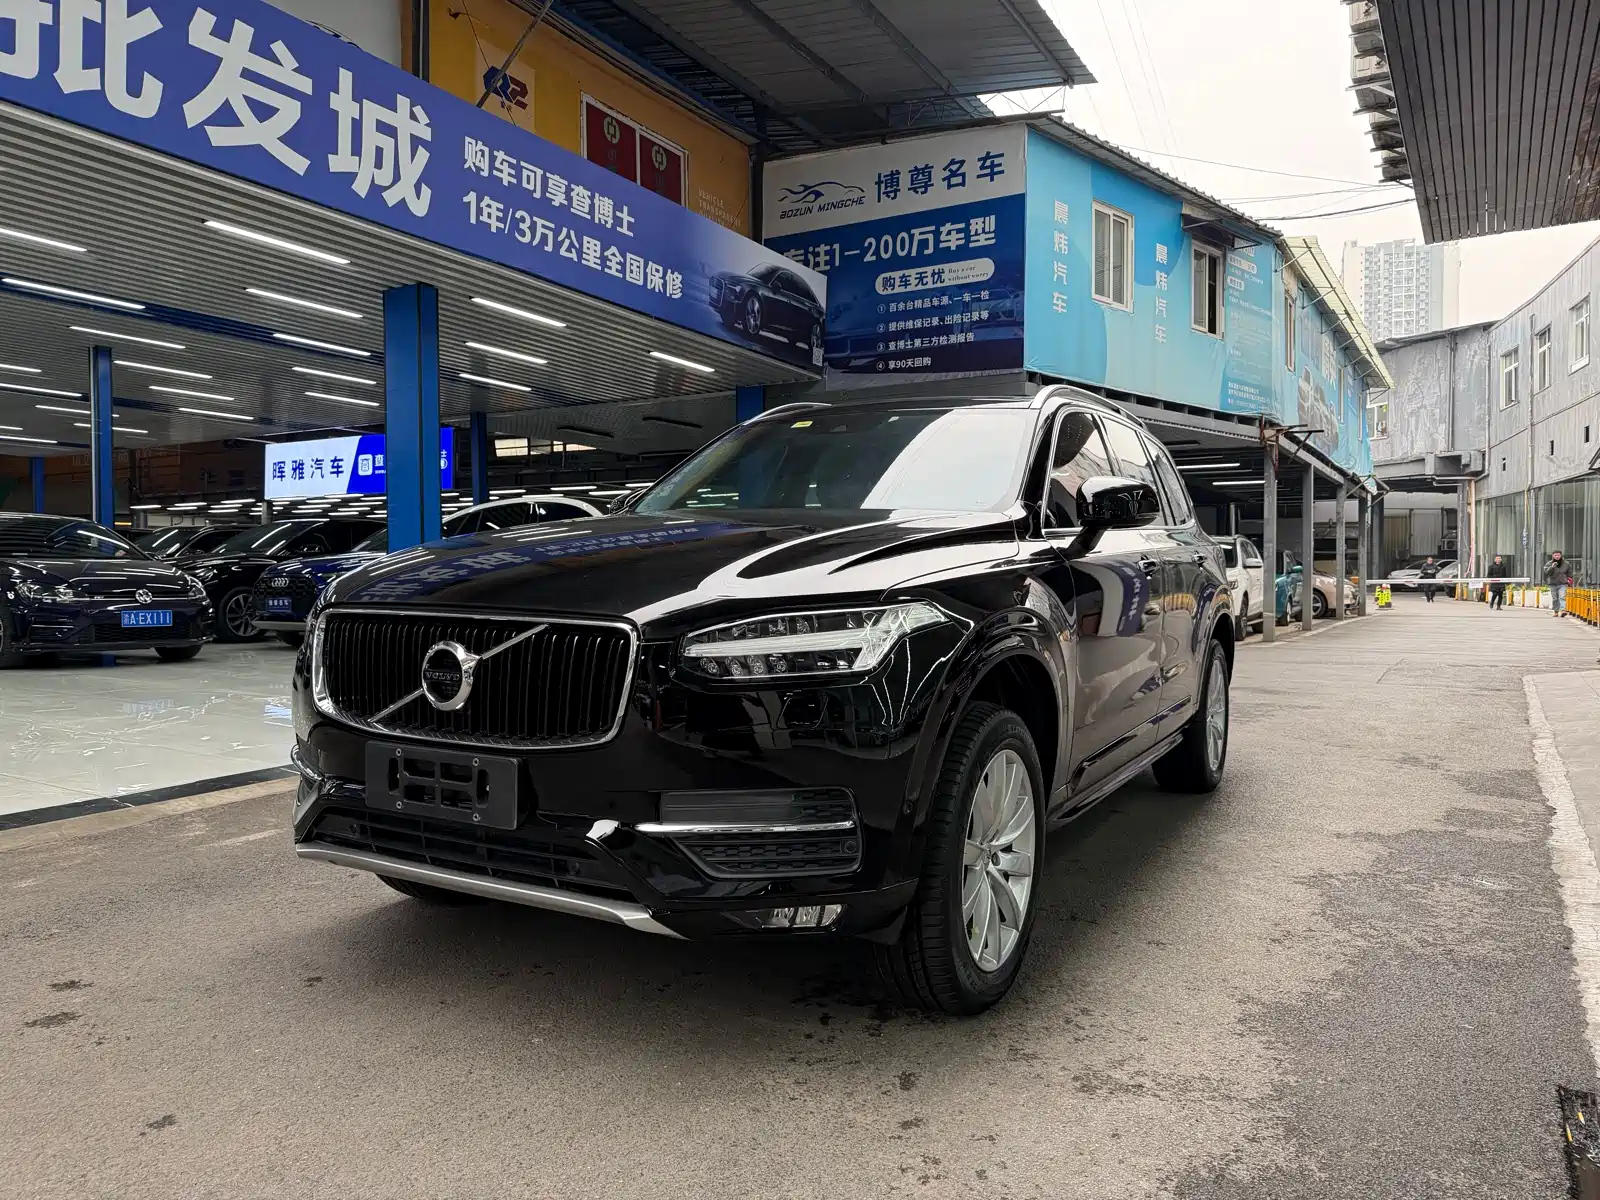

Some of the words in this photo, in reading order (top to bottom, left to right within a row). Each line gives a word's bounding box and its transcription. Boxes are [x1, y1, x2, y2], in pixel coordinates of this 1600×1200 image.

[463, 135, 635, 238] 购车可享查博士
[875, 151, 1006, 202] 博尊名车
[817, 195, 866, 213] MINGCHE
[462, 190, 684, 300] 1年/3万公里全国保修
[881, 267, 946, 292] 购车无忧
[889, 290, 990, 312] 百余台精品车源、一车一检
[888, 310, 989, 331] 提供维保记录、出险记录等
[888, 332, 974, 350] 查博士第三方检测报告
[888, 356, 932, 370] 享90天回购
[272, 455, 344, 481] 晖雅汽车
[425, 671, 460, 680] VOLVO
